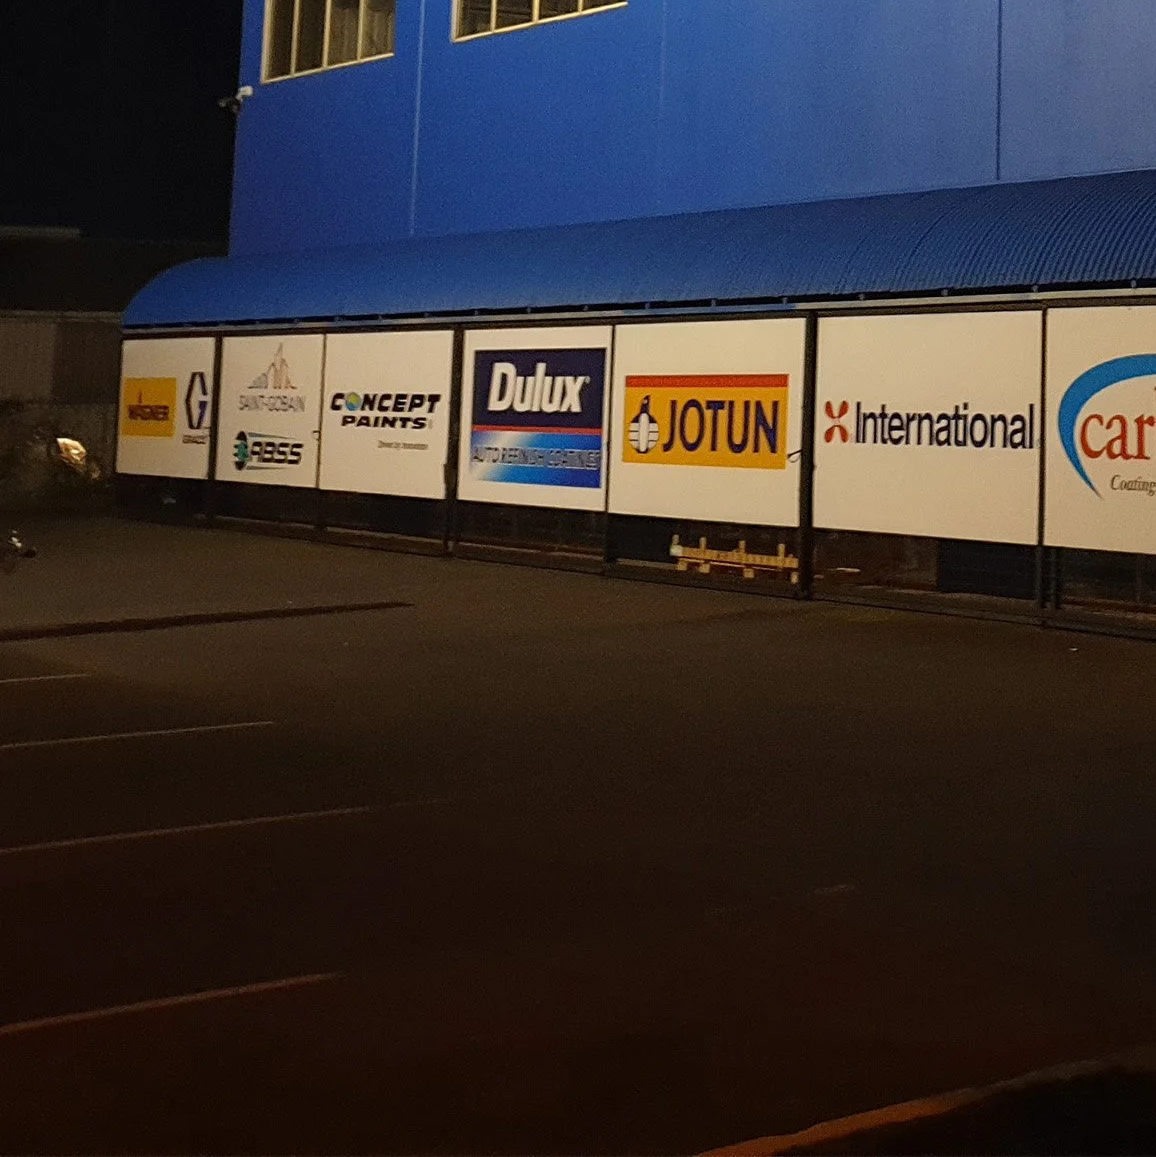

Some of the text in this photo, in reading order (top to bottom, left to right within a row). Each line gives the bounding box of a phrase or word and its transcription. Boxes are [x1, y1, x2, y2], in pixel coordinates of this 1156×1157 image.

[330, 392, 441, 414] CONCEPT
[487, 361, 585, 414] Dulux
[341, 415, 427, 430] PAINTS
[663, 398, 779, 454] JOTUN
[856, 401, 1035, 450] International
